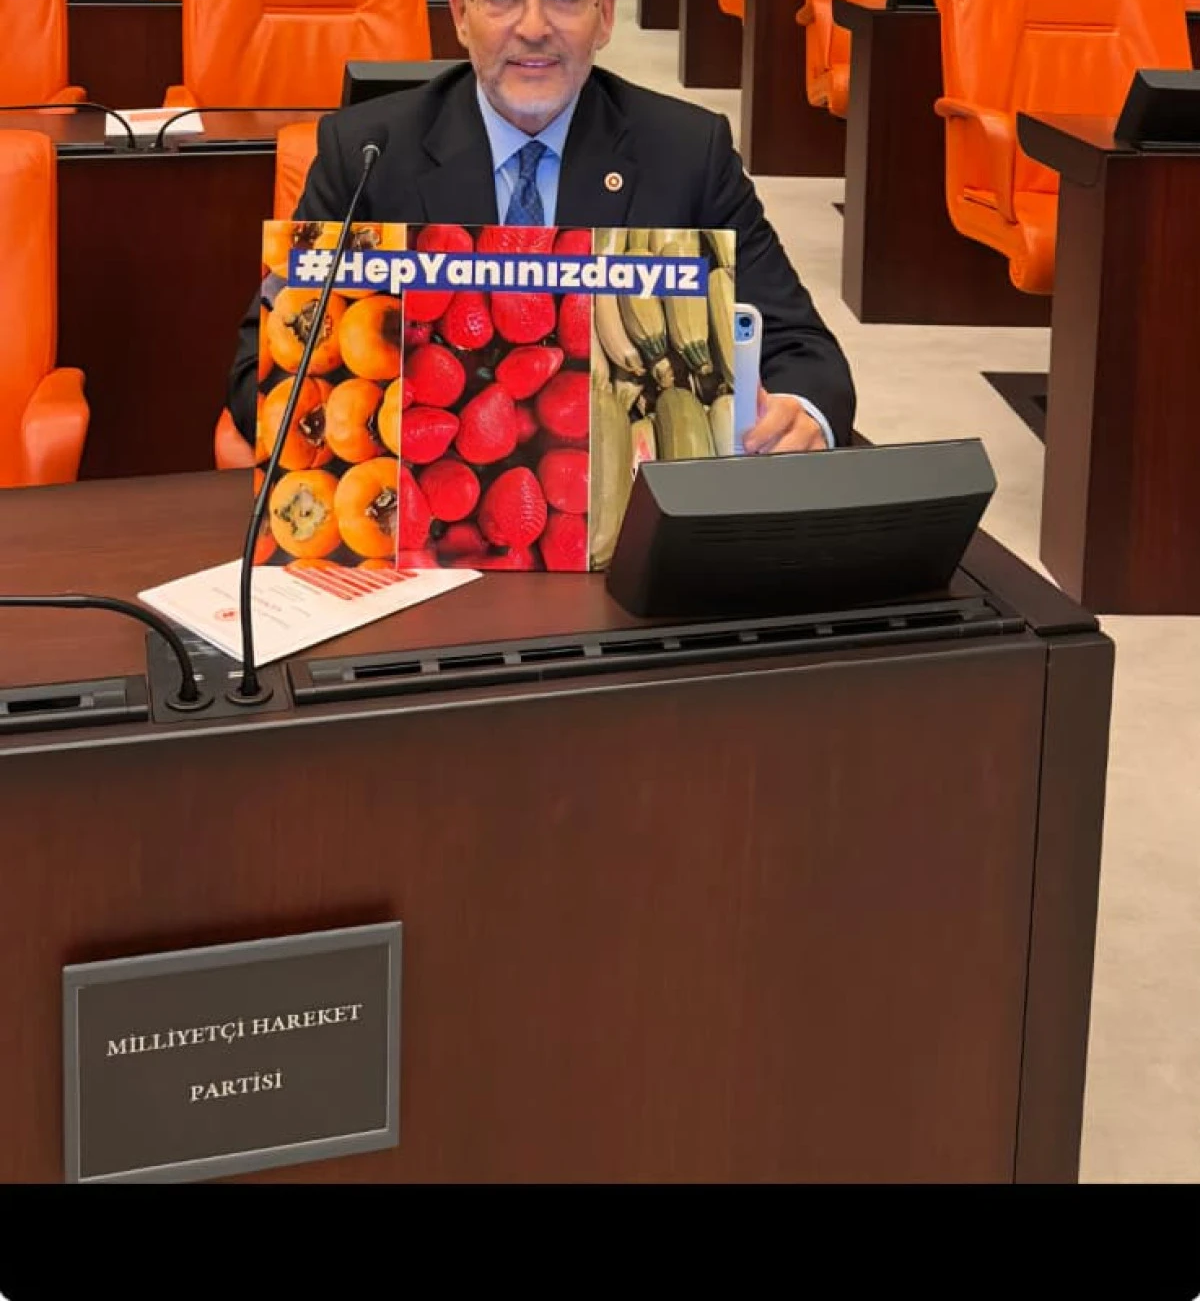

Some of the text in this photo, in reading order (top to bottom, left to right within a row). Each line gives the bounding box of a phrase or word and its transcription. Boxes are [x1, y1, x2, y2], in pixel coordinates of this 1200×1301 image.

[295, 250, 700, 299] #HepYanınızdayız
[106, 1003, 363, 1056] MİLLİYETÇİ HAREKET
[190, 1068, 283, 1102] PARTİSİ
